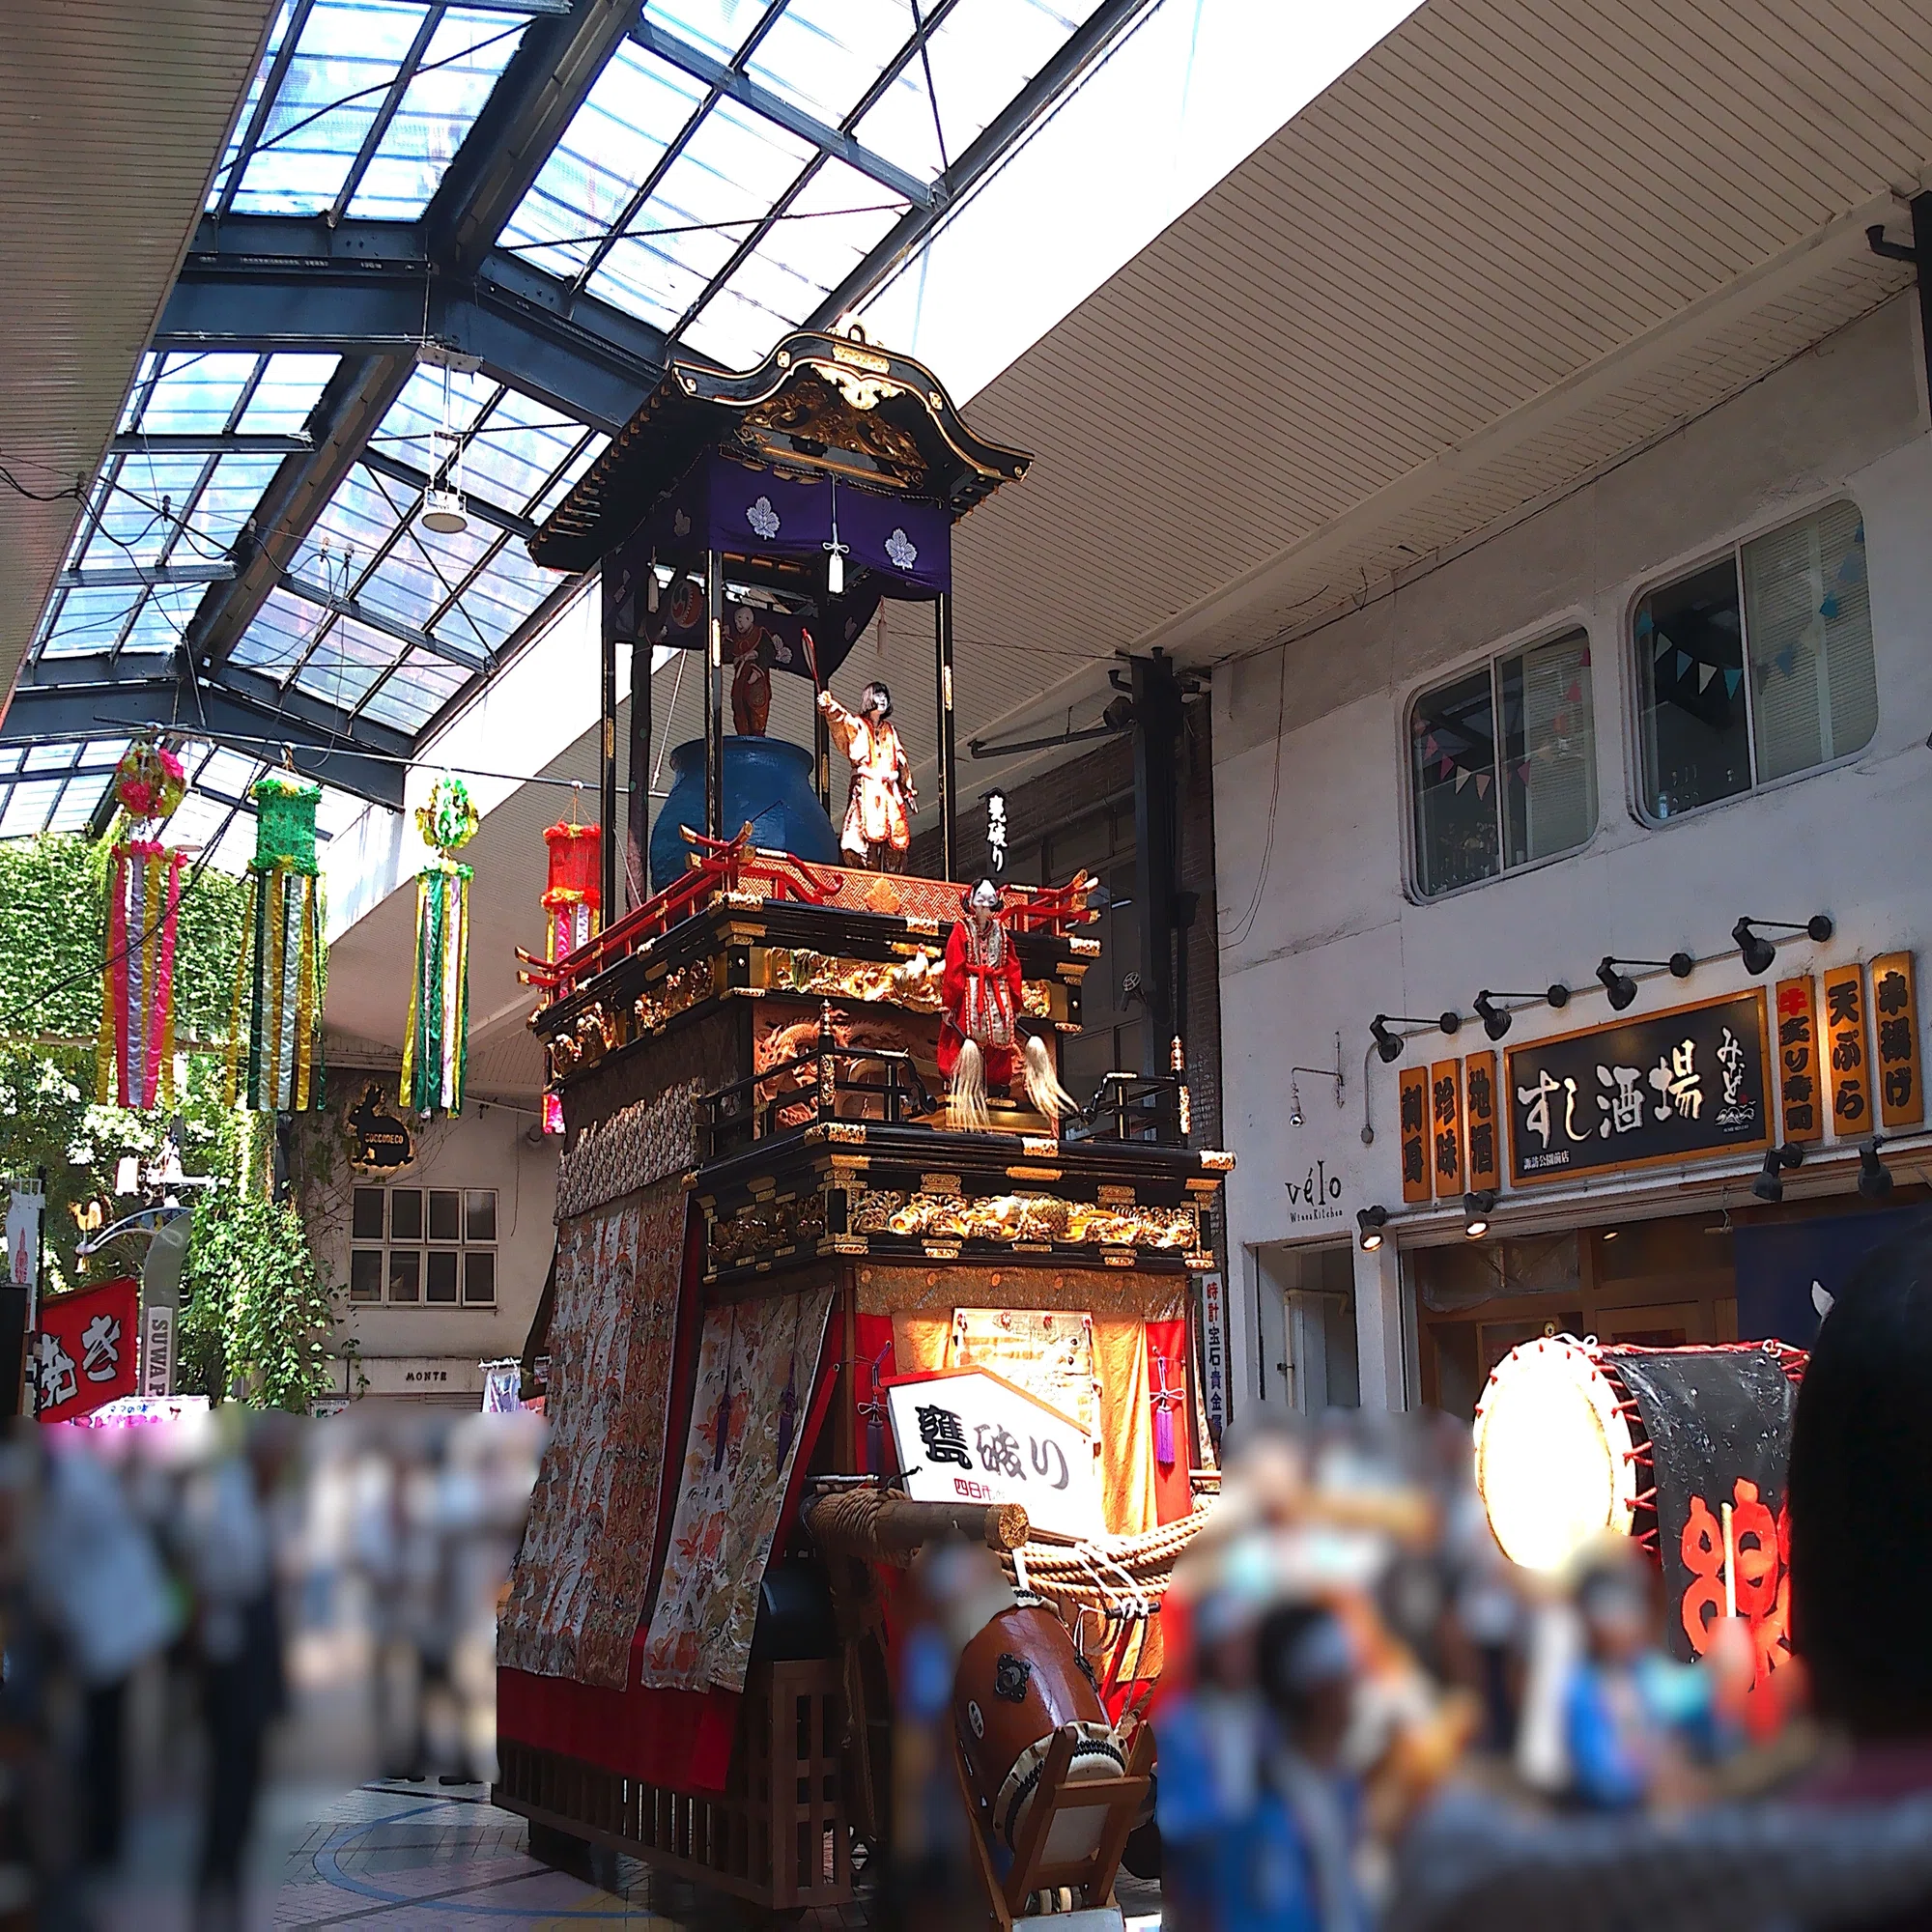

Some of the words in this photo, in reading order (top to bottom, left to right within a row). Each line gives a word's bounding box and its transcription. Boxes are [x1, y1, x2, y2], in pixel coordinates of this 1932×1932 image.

[1779, 988, 1814, 1131] 牛炙り寿司
[1829, 980, 1864, 1120] 天ぷら
[1878, 971, 1912, 1107] 串揚げ
[1435, 1076, 1457, 1179] 珍味
[1469, 1066, 1492, 1175] 地酒
[1518, 1039, 1705, 1149] すし酒場
[1284, 1160, 1342, 1207] vélo
[150, 1320, 168, 1378] SUWA
[406, 1371, 447, 1381] MONTE
